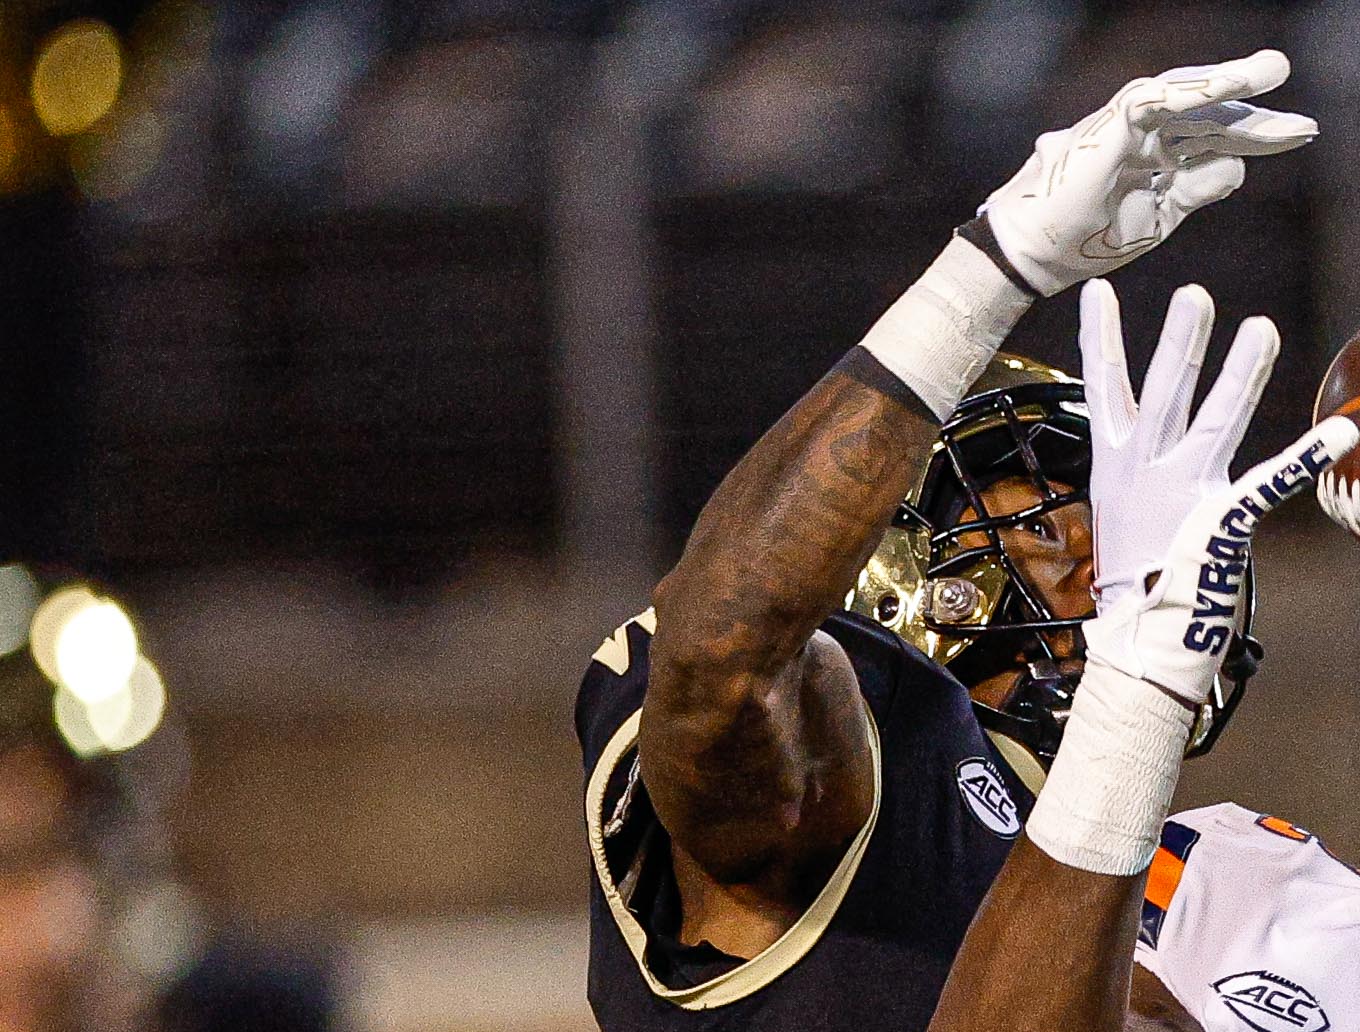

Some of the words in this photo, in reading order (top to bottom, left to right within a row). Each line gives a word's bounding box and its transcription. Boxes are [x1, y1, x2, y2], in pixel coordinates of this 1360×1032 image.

[1182, 439, 1333, 657] SYRACUSE
[965, 775, 1015, 823] ACC
[1235, 985, 1319, 1024] ACC
